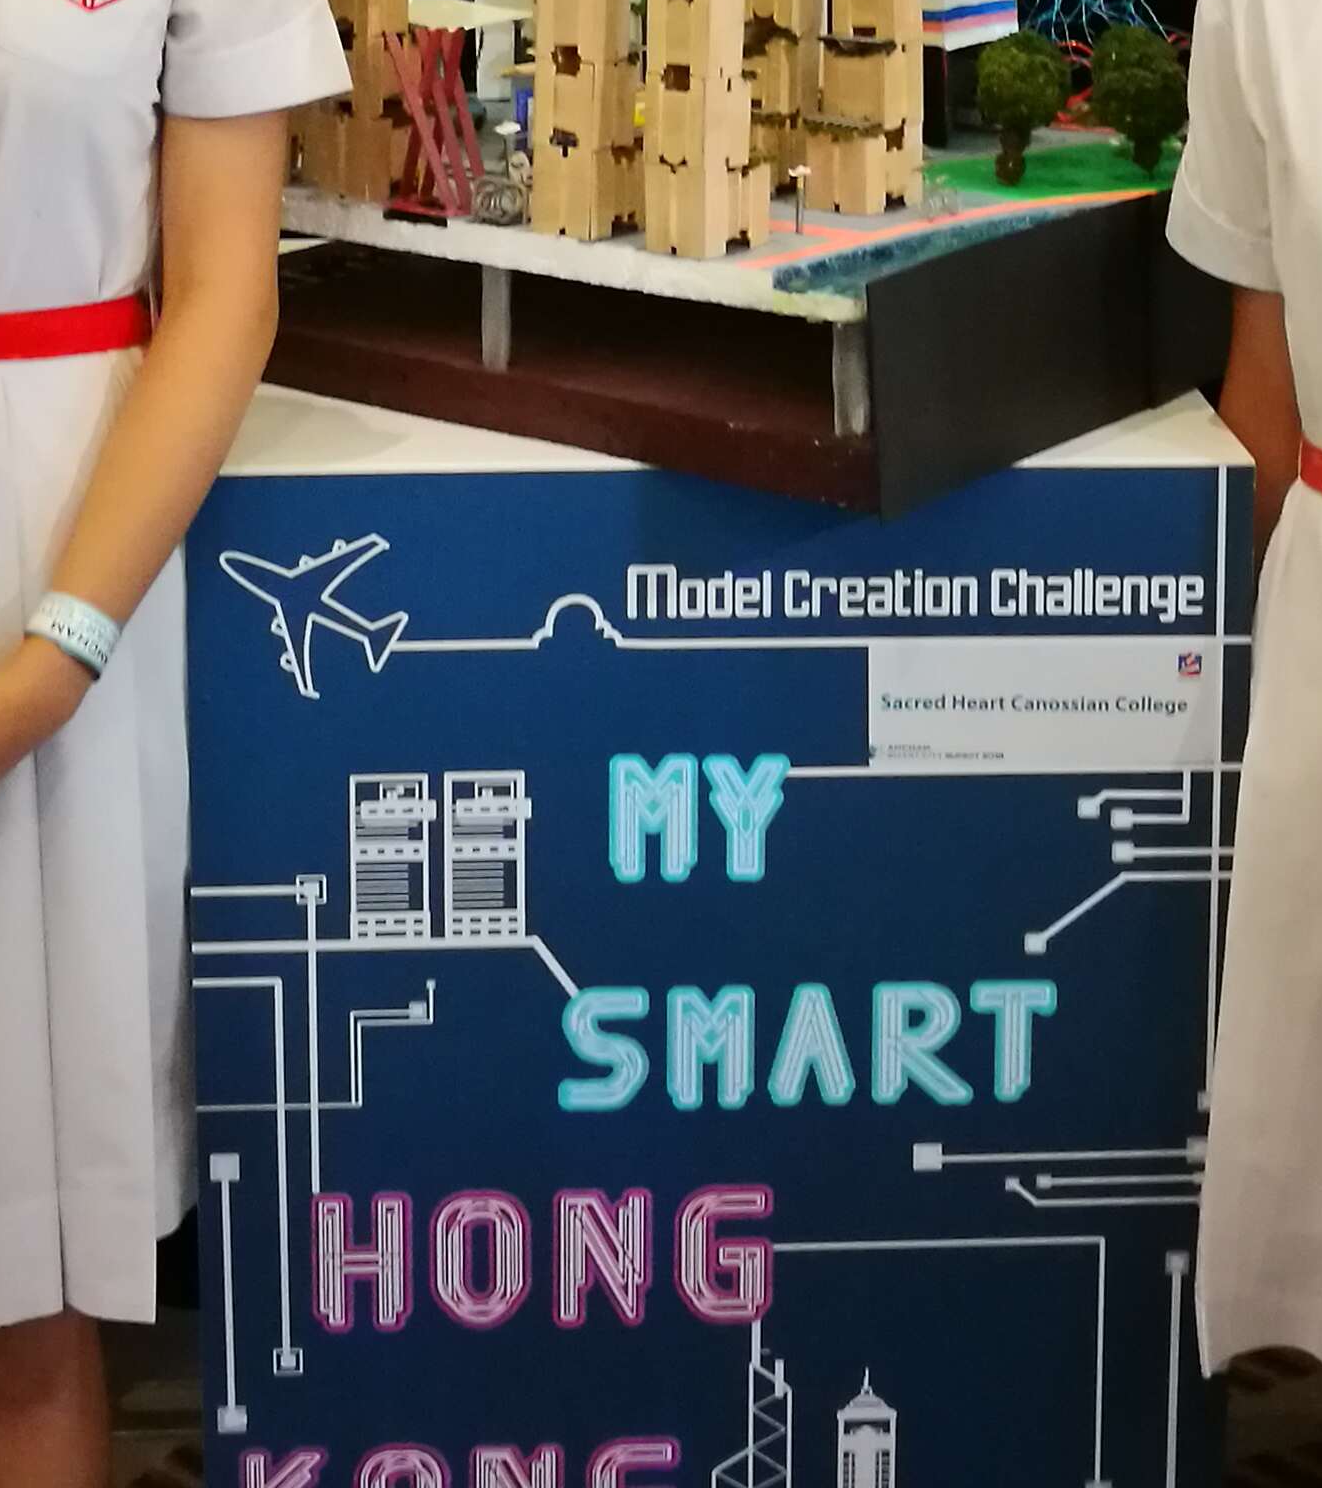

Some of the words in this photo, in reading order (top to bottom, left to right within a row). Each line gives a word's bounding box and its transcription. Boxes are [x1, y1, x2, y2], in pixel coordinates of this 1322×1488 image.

[627, 563, 771, 619] Model
[784, 568, 979, 618] Creation
[990, 568, 1204, 623] Challenge
[881, 693, 946, 710] Sacred
[952, 694, 1004, 711] Heart
[1011, 693, 1109, 712] Canossian
[1115, 695, 1188, 716] College
[609, 752, 791, 884] MY
[558, 981, 1057, 1111] SMART
[312, 1185, 772, 1330] HONG
